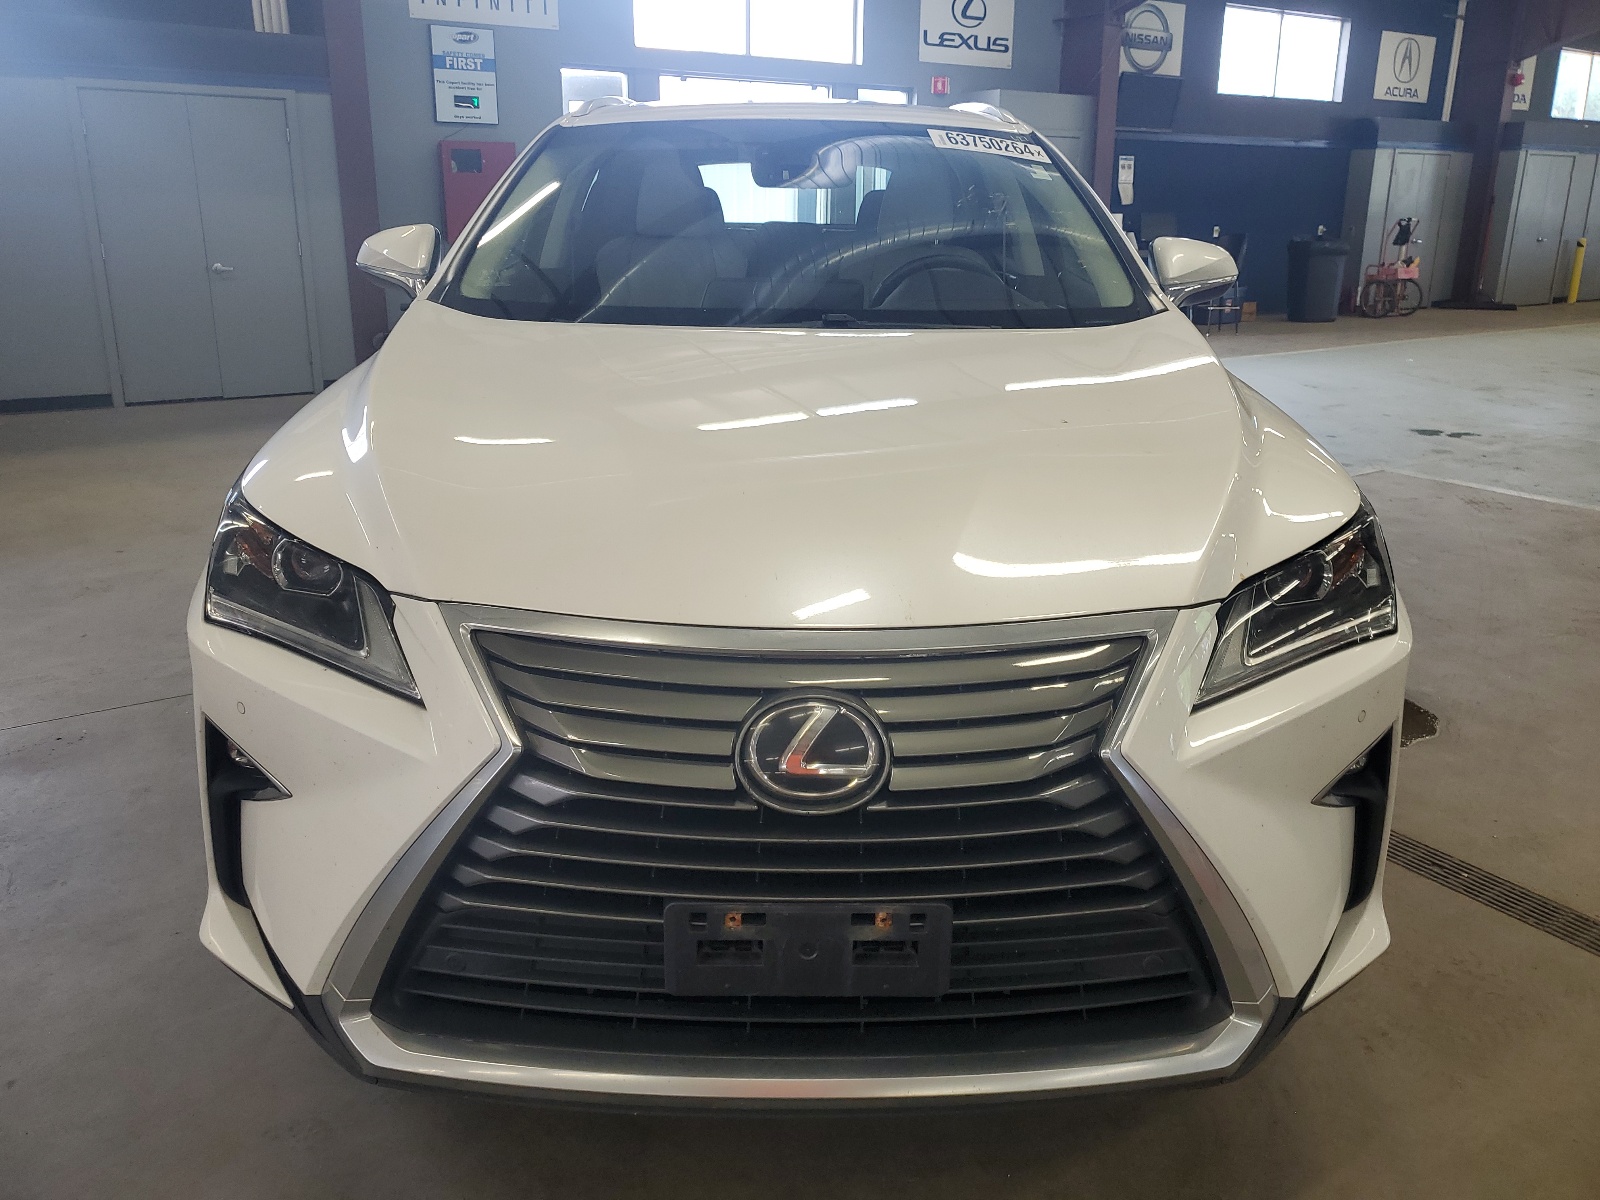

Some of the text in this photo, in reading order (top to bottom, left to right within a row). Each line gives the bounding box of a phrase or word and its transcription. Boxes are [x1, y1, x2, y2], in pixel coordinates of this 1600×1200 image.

[421, 0, 547, 15] INITI
[923, 30, 1009, 53] LEXUS
[1125, 32, 1168, 46] NISSAN
[445, 56, 483, 70] FIRST
[1384, 86, 1419, 98] ACURA
[945, 132, 1035, 157] 63750264
